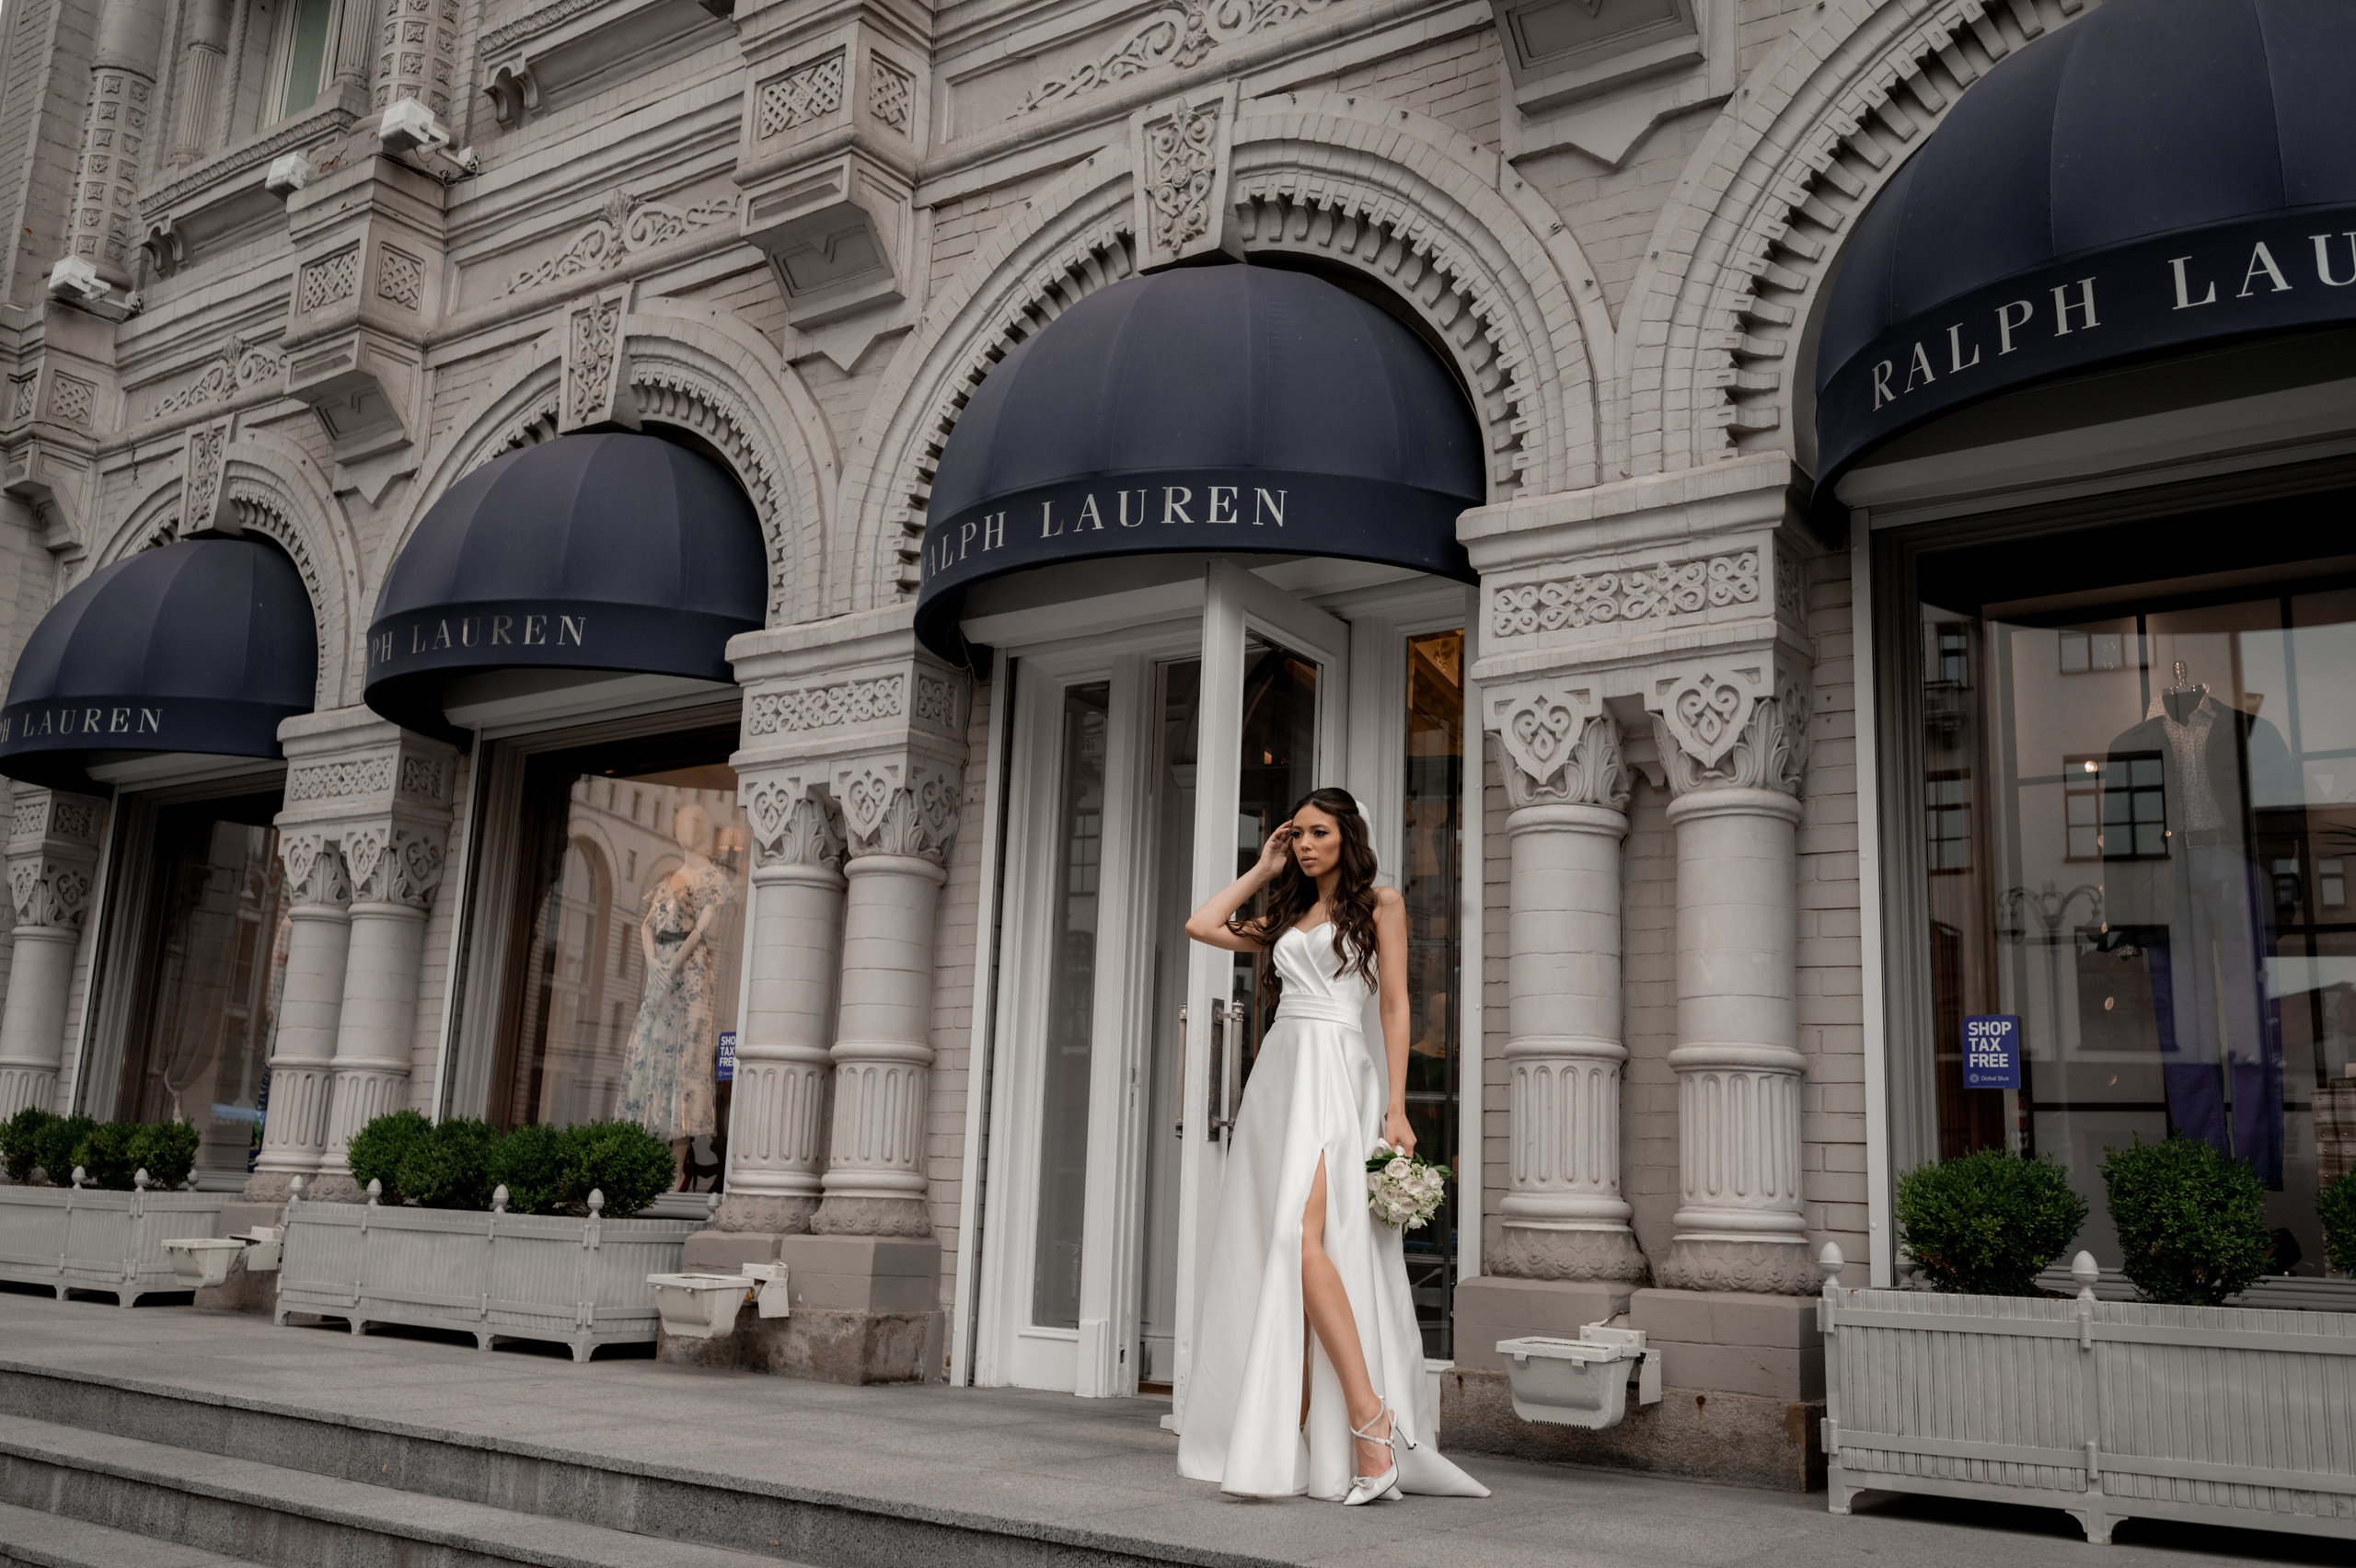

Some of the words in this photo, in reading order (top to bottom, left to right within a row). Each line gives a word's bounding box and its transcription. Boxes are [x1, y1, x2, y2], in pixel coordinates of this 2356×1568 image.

[1872, 277, 2101, 411] RALPH
[2167, 232, 2356, 311] LAU
[1039, 486, 1288, 539] LAUREN
[411, 615, 586, 654] LAUREN
[22, 708, 163, 737] LAUREN
[1968, 1021, 2012, 1036] SHOP
[720, 1046, 735, 1056] TAX
[1969, 1037, 2001, 1052] TAX
[1969, 1053, 2009, 1068] FREE
